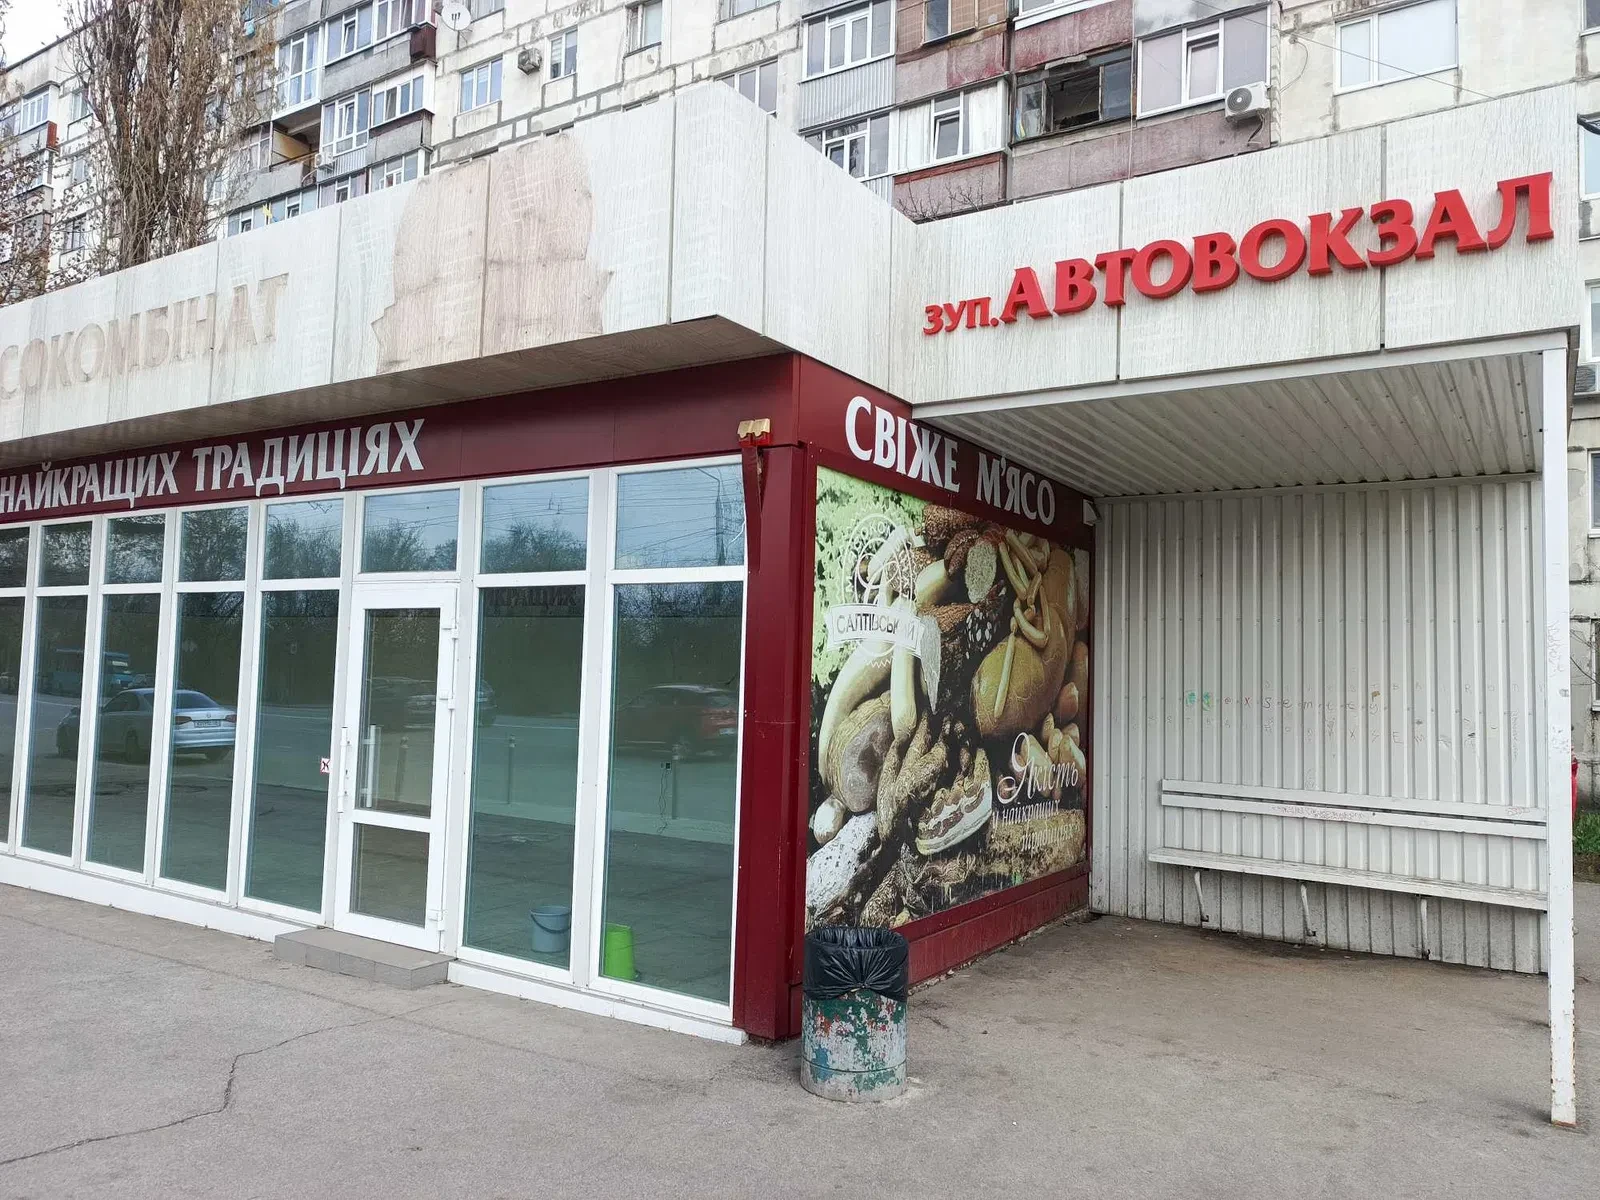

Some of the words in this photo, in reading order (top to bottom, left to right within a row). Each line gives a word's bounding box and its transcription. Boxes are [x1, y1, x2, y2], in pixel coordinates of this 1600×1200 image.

[1000, 171, 1554, 324] АВТОВОКЗАЛ
[0, 450, 181, 509] НАЙКРАЩИХ
[191, 418, 425, 498] ТРАДИЦІЯХ
[844, 395, 961, 494] СВІЖЕ
[975, 451, 1056, 527] М'ЯСО
[996, 731, 1080, 805] Якість
